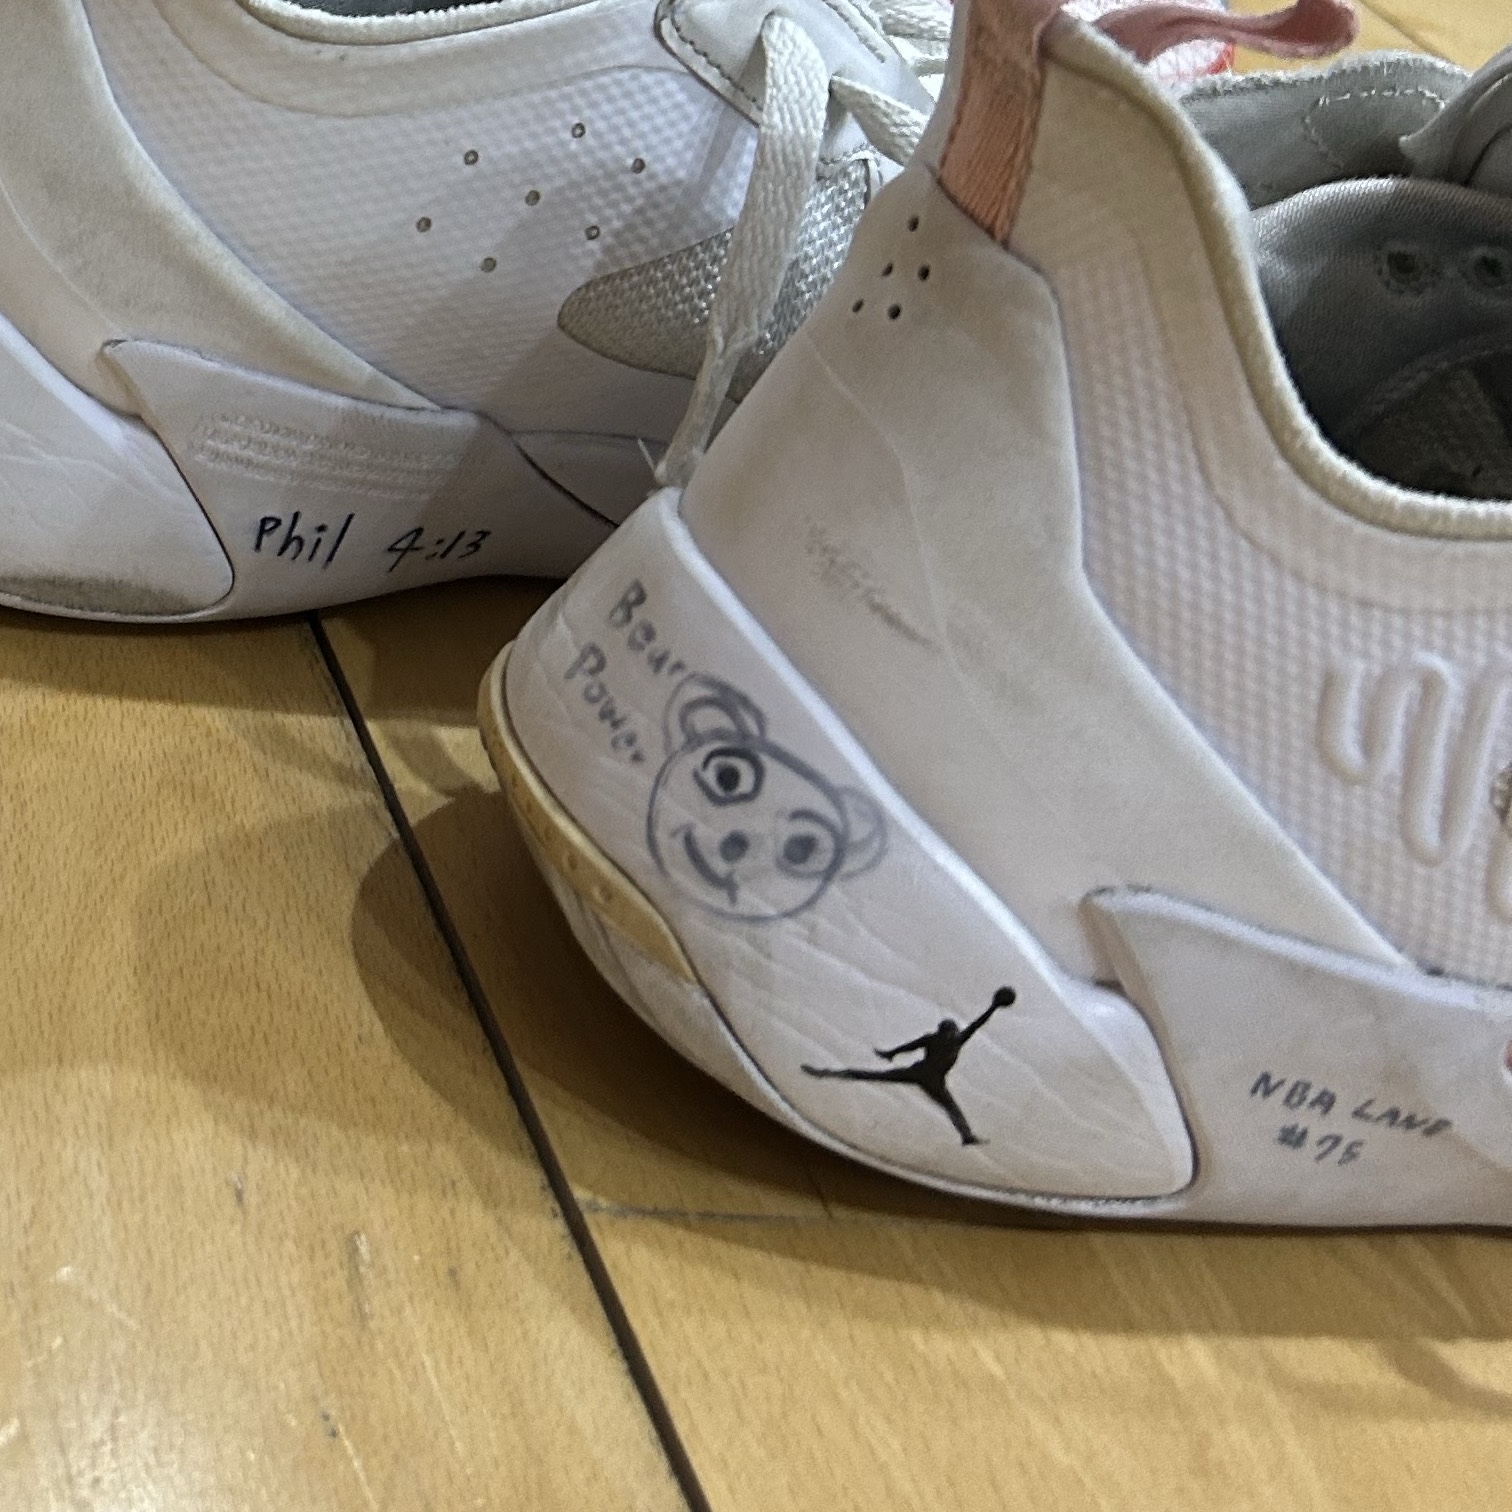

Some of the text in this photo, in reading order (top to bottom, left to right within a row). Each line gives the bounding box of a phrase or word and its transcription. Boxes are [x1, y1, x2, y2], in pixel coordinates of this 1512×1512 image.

[252, 510, 491, 573] Phil 4:13
[608, 579, 689, 679] Bear
[564, 645, 647, 764] Power
[1249, 1071, 1337, 1116] NBA
